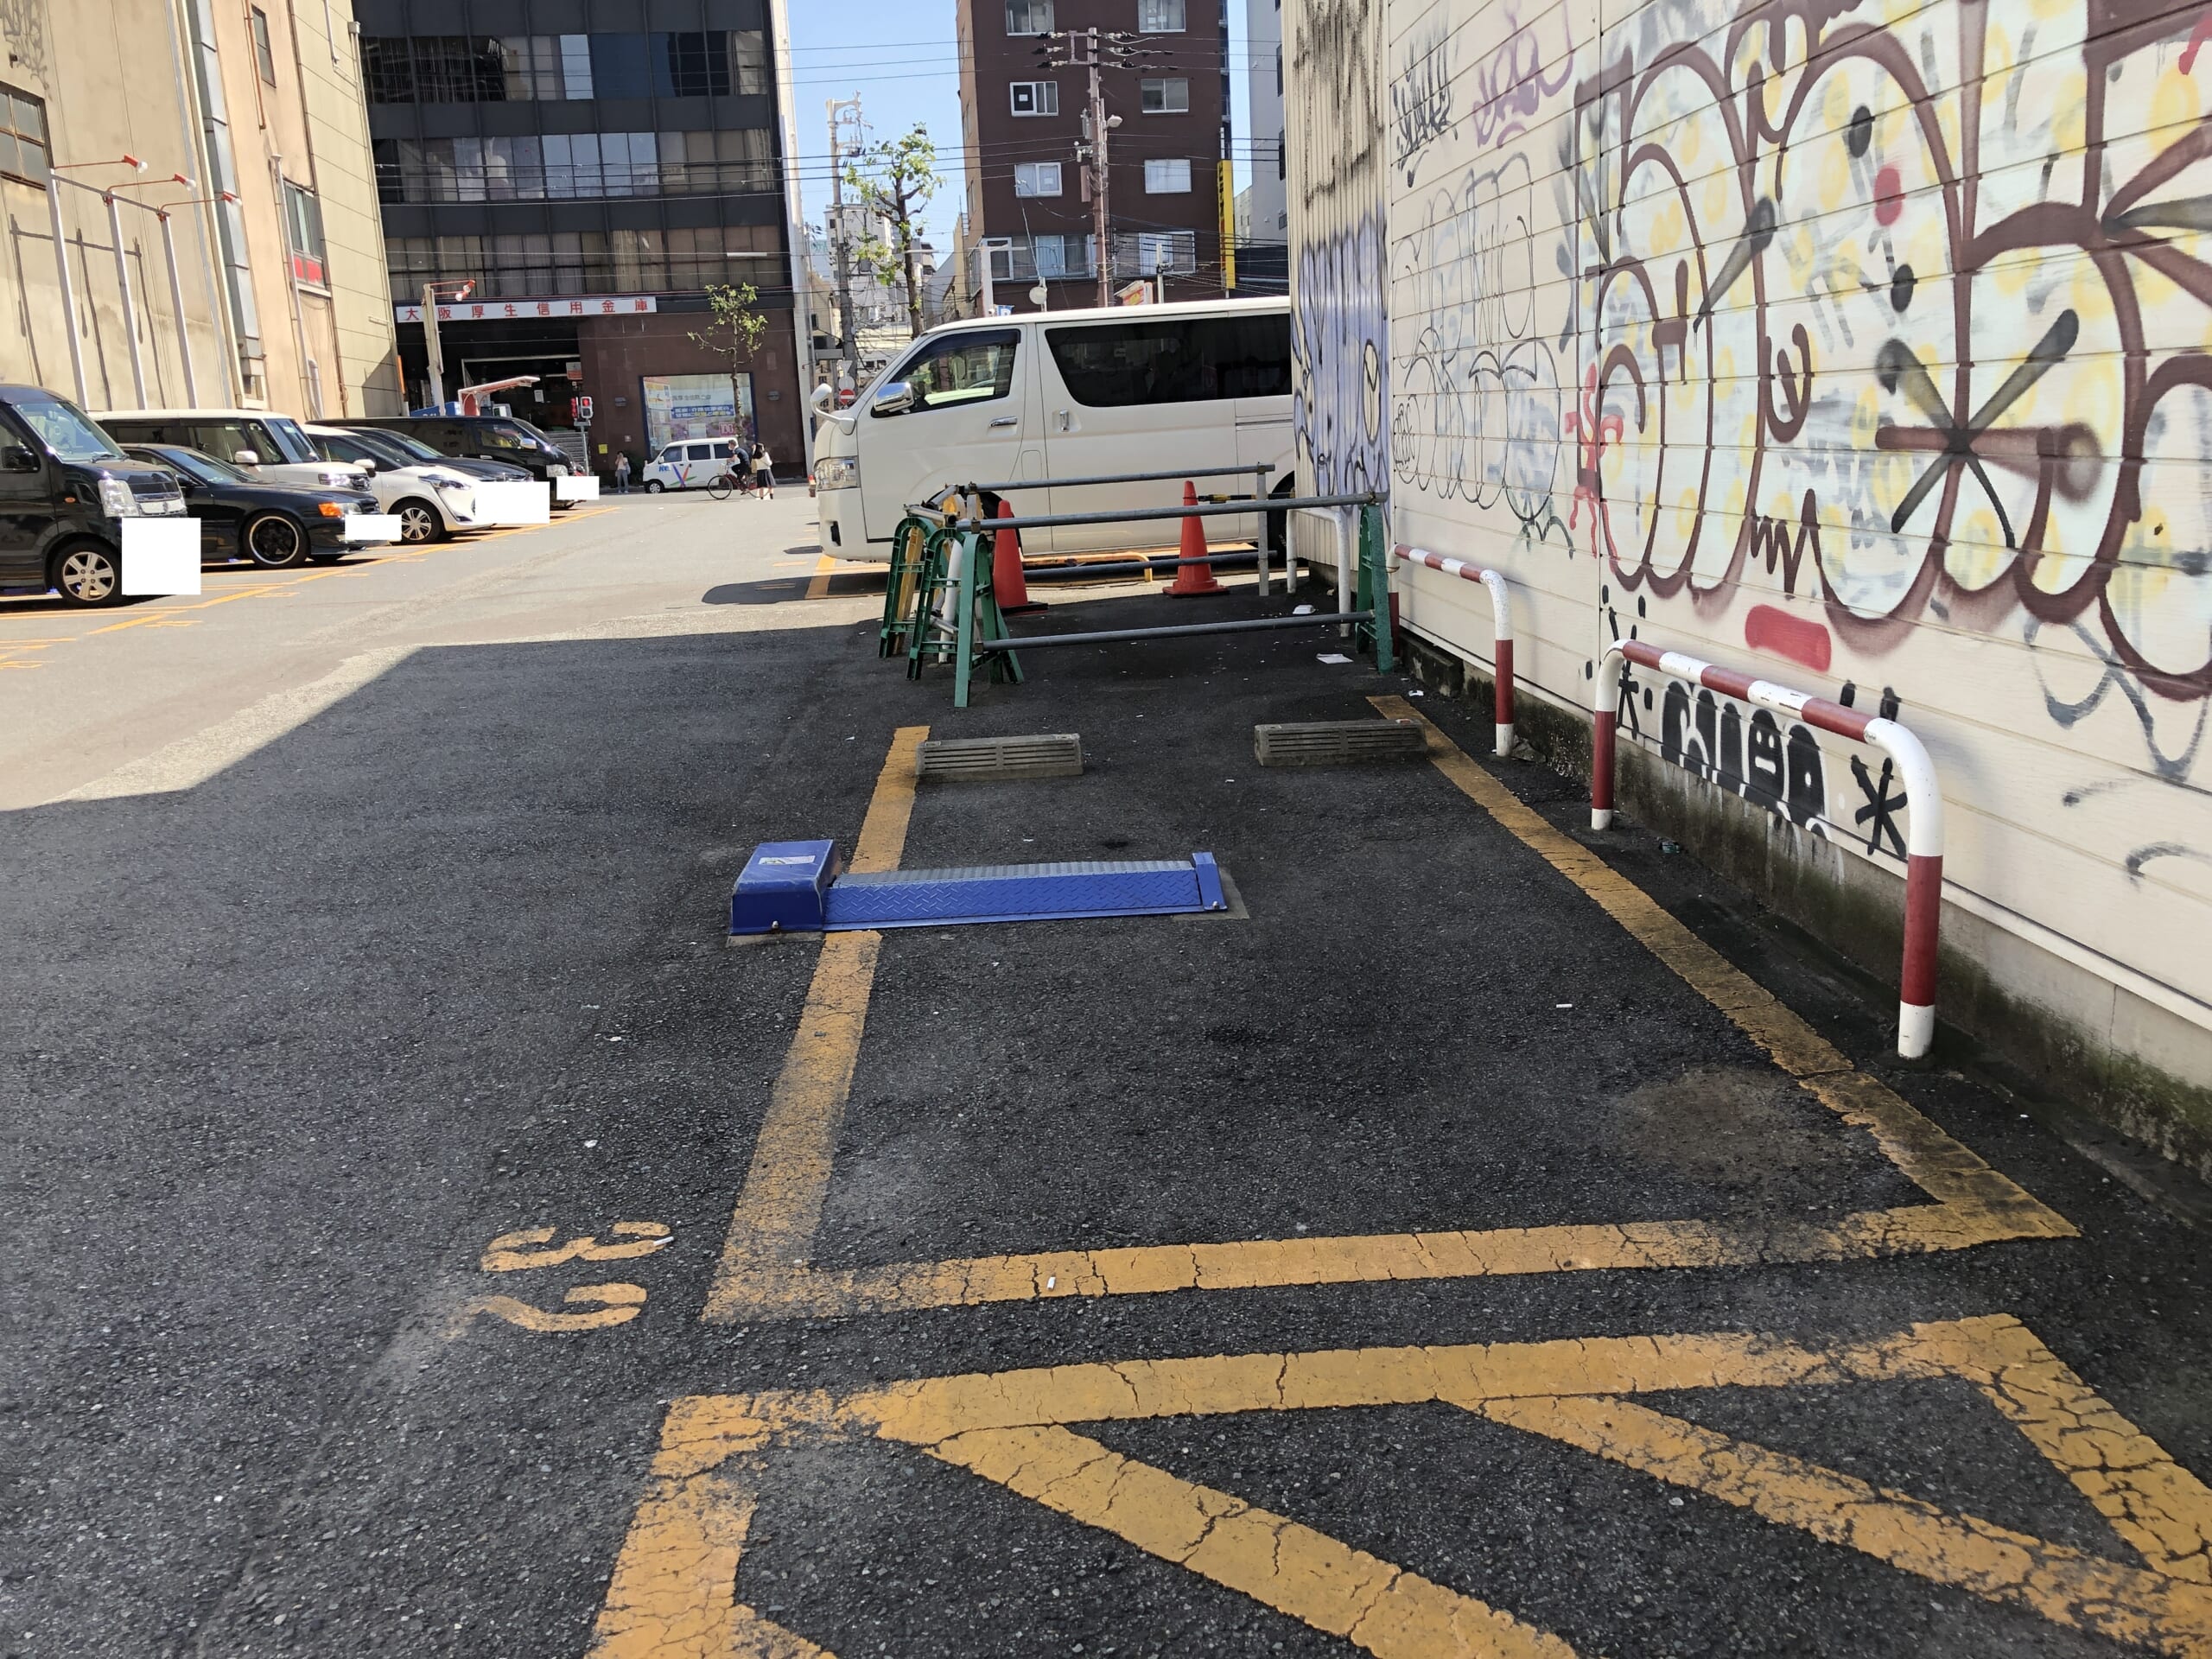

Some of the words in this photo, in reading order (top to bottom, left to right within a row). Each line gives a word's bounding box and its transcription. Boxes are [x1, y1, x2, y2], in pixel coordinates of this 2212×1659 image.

[406, 299, 649, 321] 大阪厚生信用金庫
